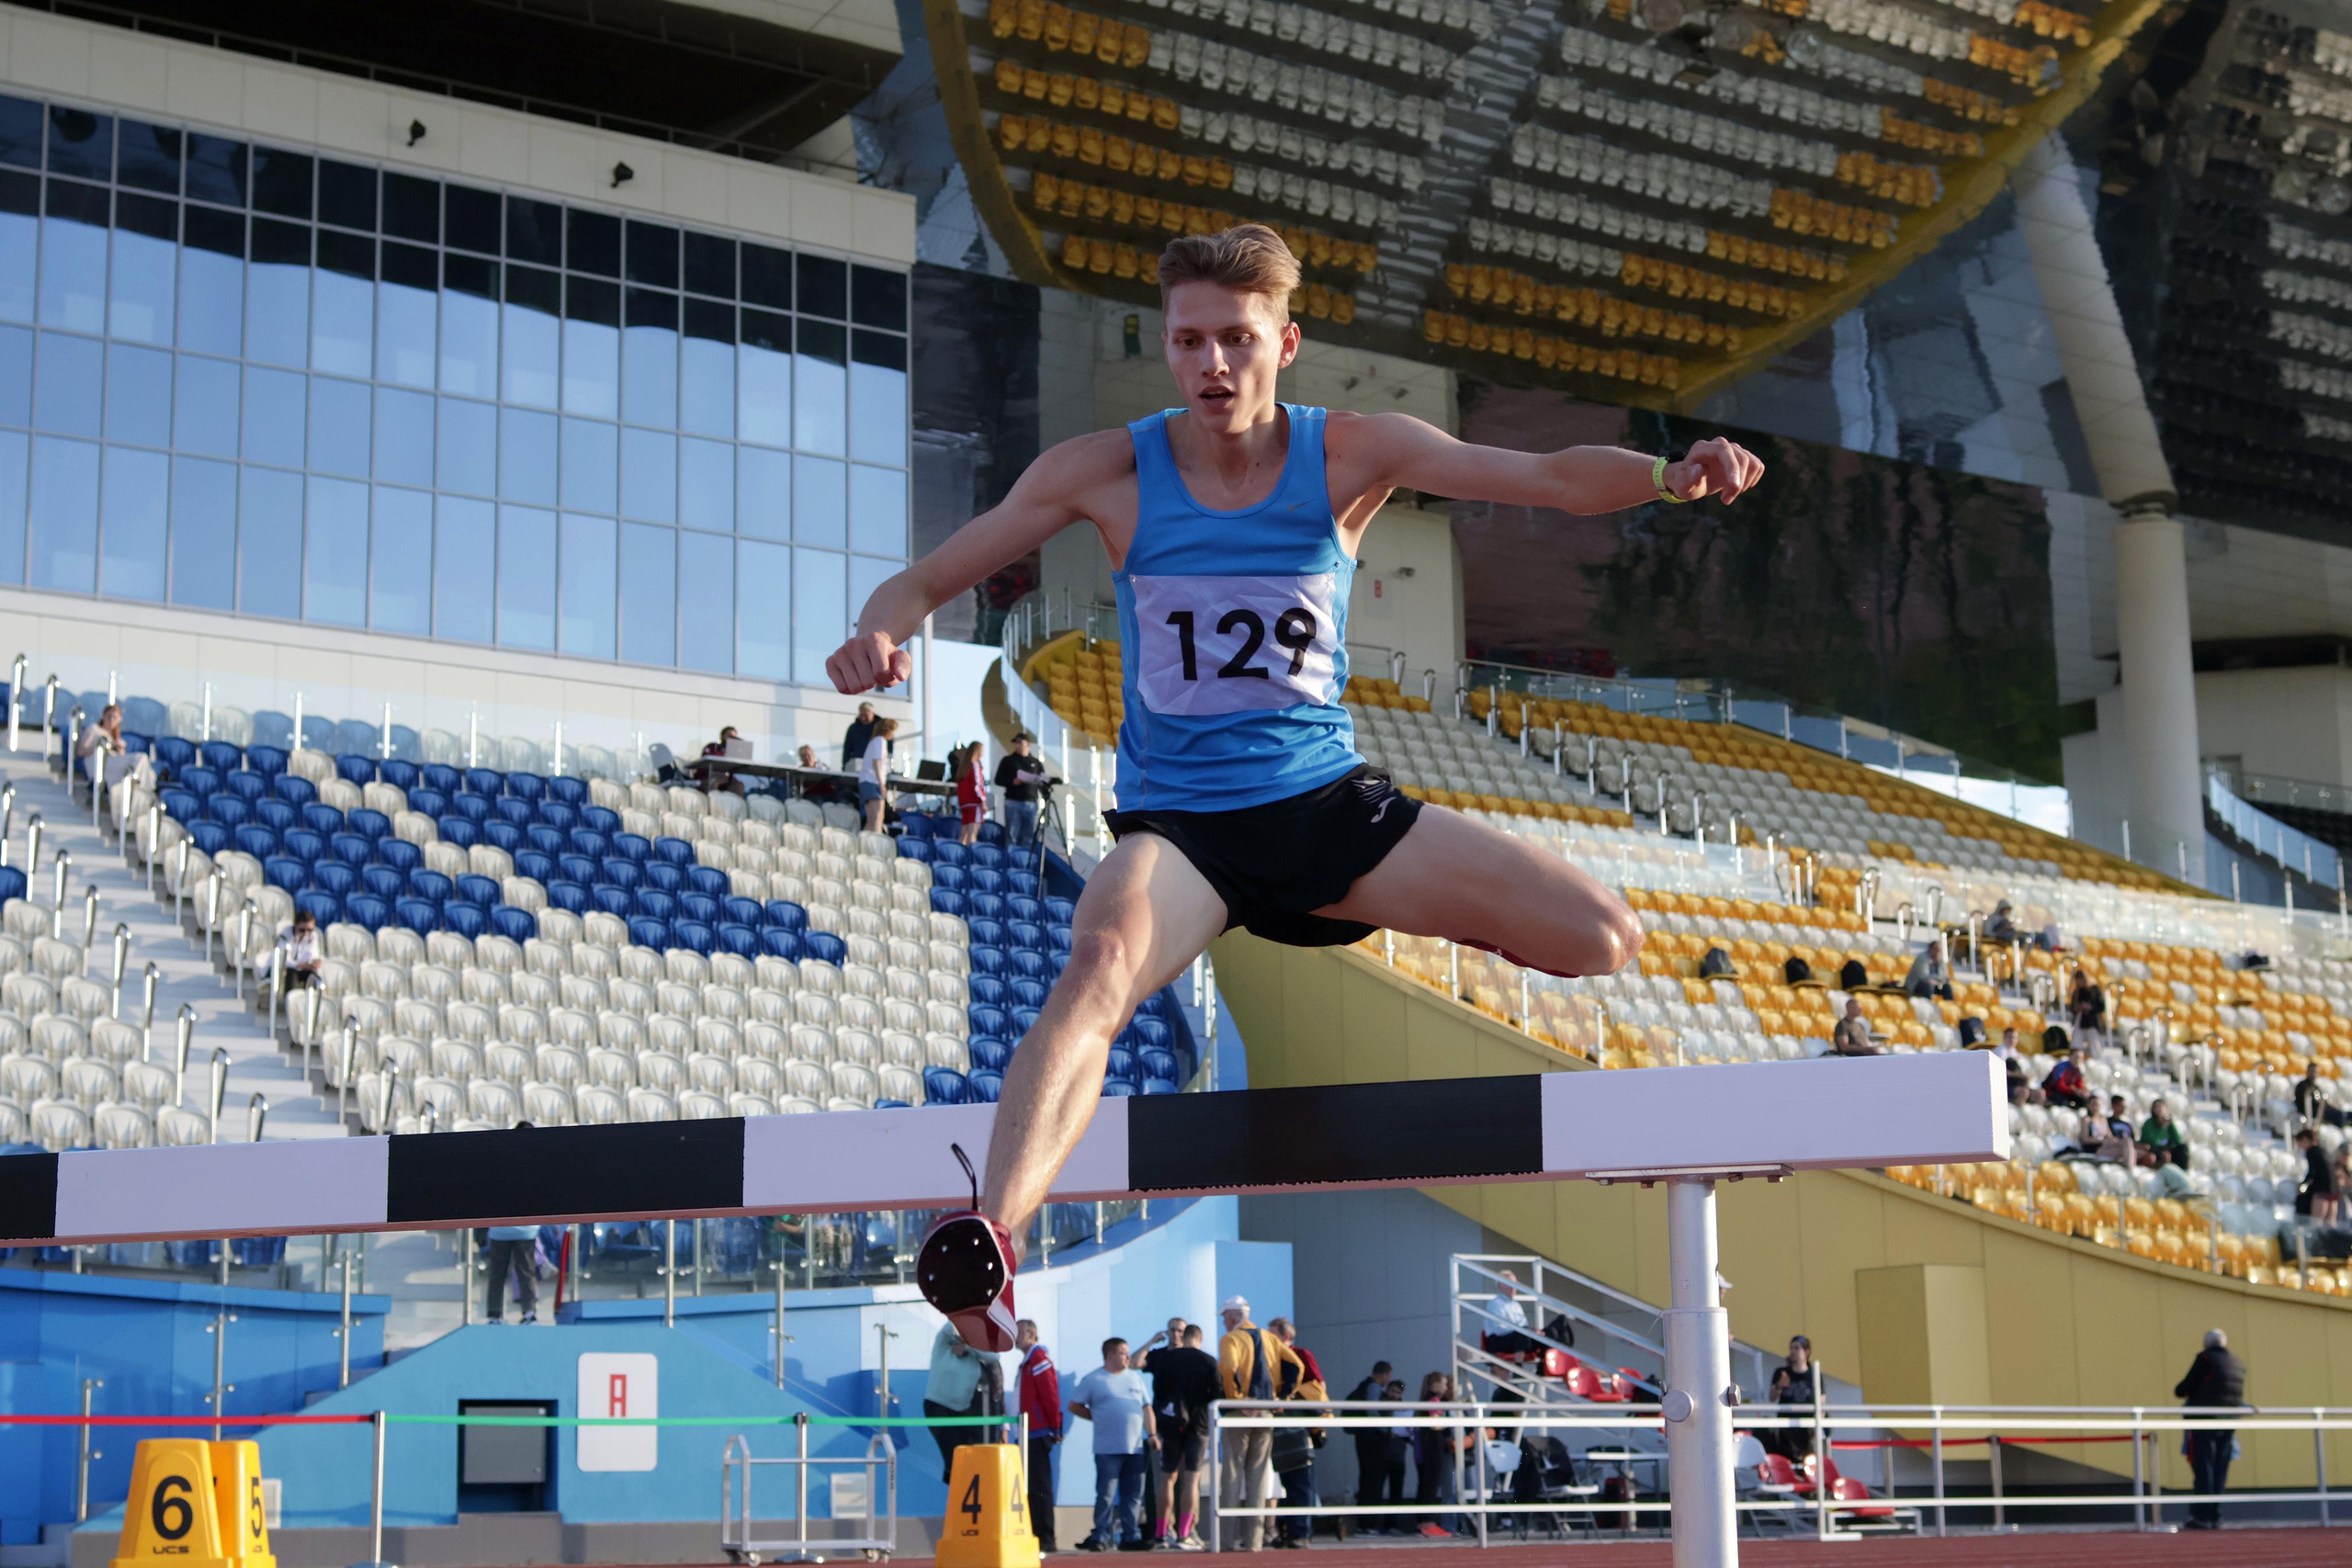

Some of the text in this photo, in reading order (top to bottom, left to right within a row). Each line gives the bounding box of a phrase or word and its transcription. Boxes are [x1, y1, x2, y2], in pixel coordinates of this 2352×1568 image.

[1166, 607, 1317, 681] 129
[609, 1374, 627, 1417] A
[152, 1475, 193, 1540] 6
[251, 1477, 262, 1539] 5
[961, 1474, 981, 1525] 4
[1011, 1474, 1023, 1523] 4
